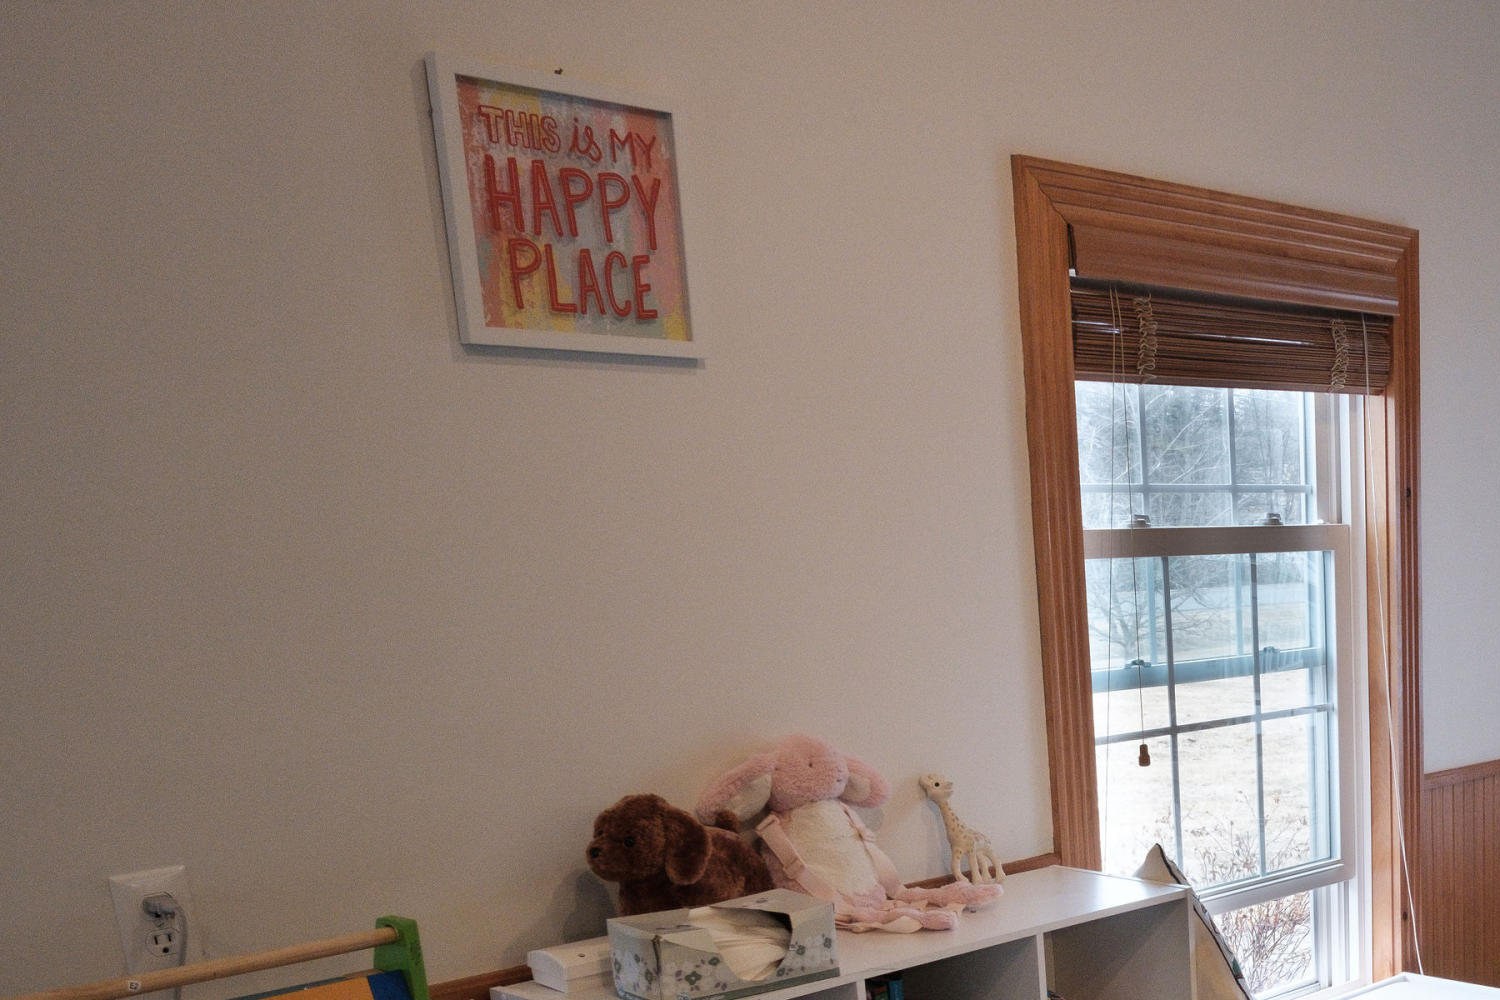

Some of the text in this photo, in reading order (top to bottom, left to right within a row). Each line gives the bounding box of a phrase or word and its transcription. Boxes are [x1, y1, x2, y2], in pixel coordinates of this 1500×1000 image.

[478, 104, 657, 169] THIS is MY
[483, 154, 661, 251] HAPPY
[508, 237, 659, 320] PLACE
